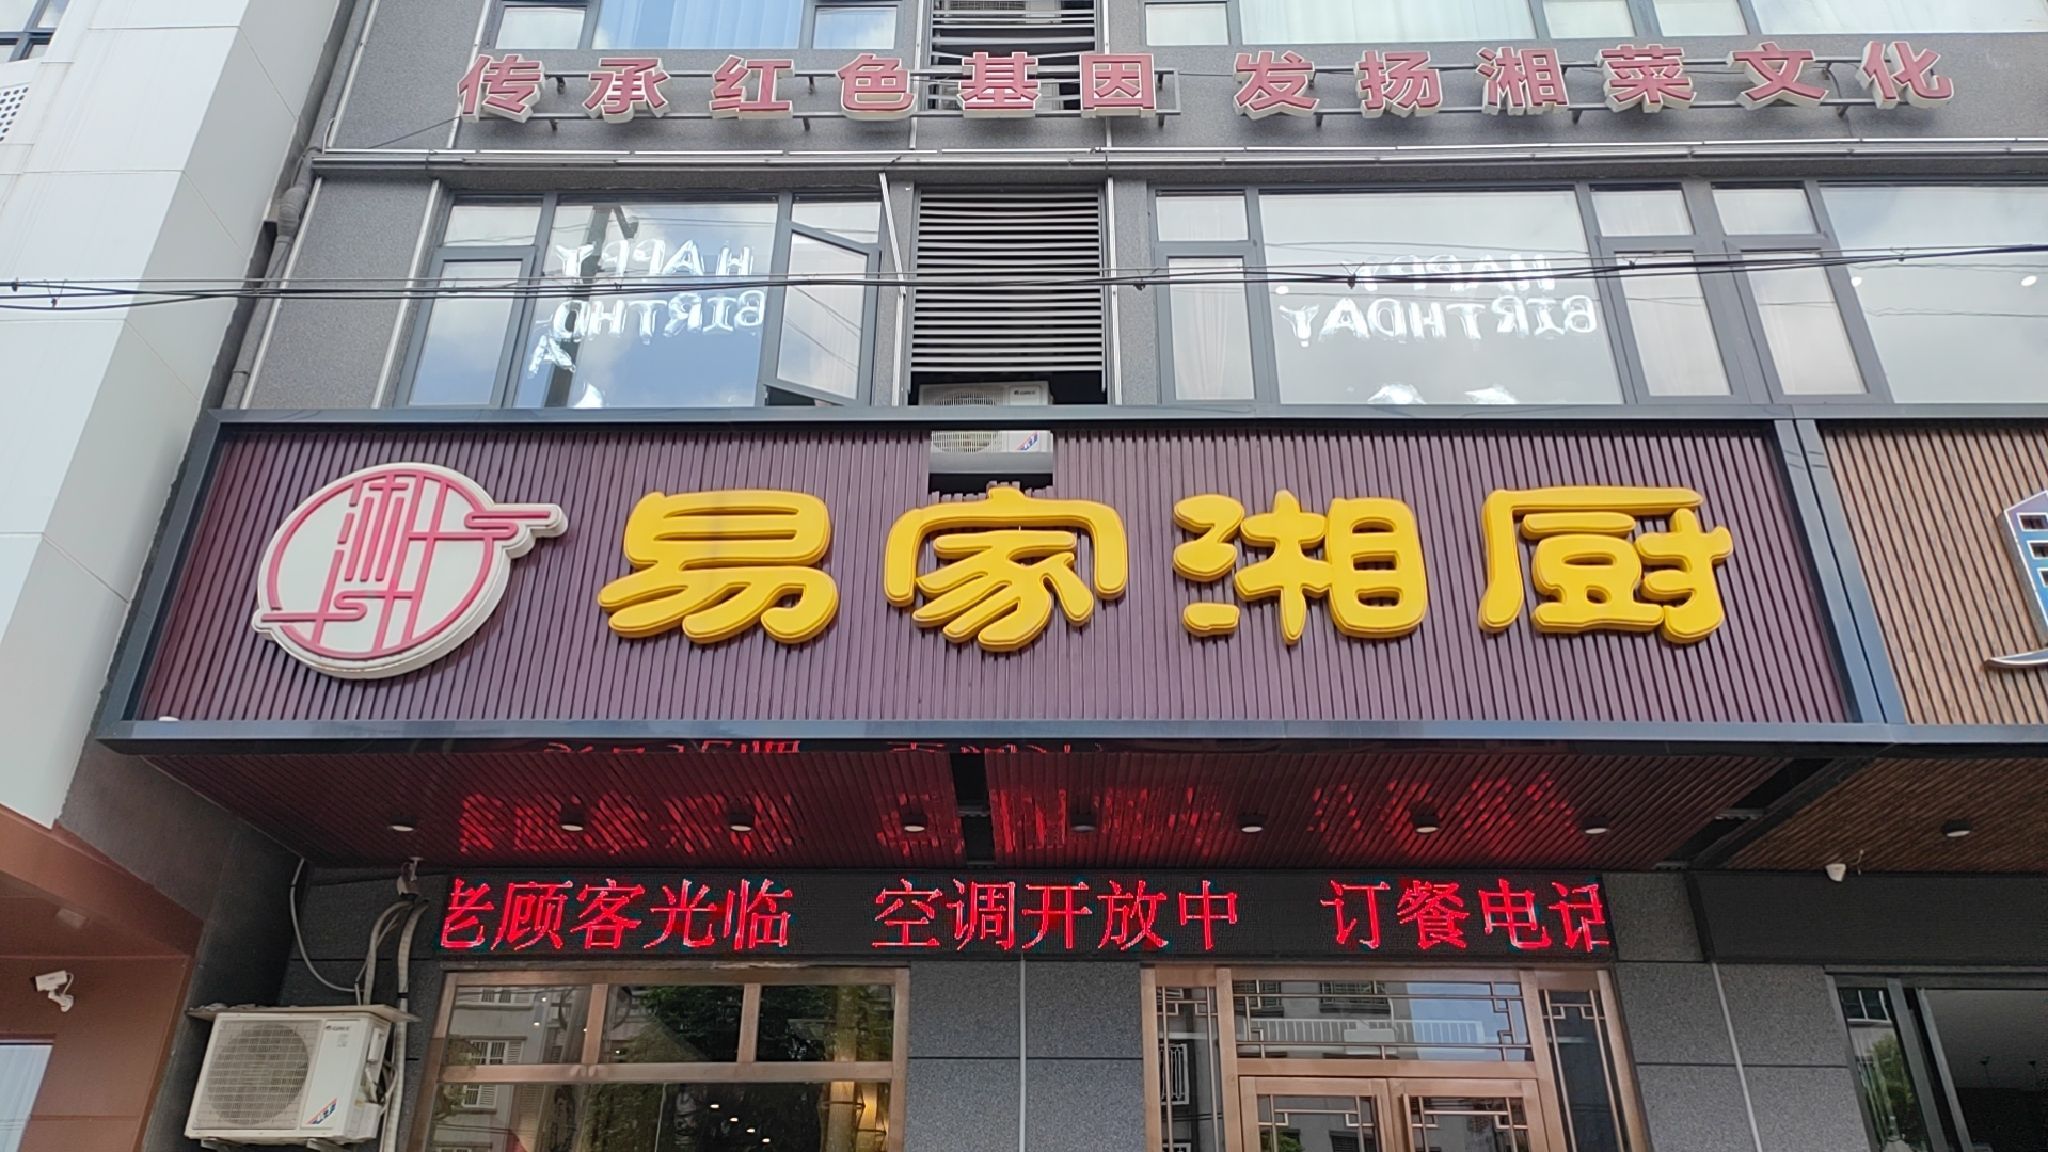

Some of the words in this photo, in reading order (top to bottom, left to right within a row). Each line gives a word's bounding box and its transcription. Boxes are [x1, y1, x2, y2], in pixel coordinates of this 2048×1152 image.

[457, 50, 1157, 124] 传承红色基因
[1232, 40, 1956, 118] 发扬湘菜文化
[598, 484, 1734, 652] 易家湘厨
[440, 877, 794, 951] 老顾客光临
[871, 878, 1239, 951] 空调开放中
